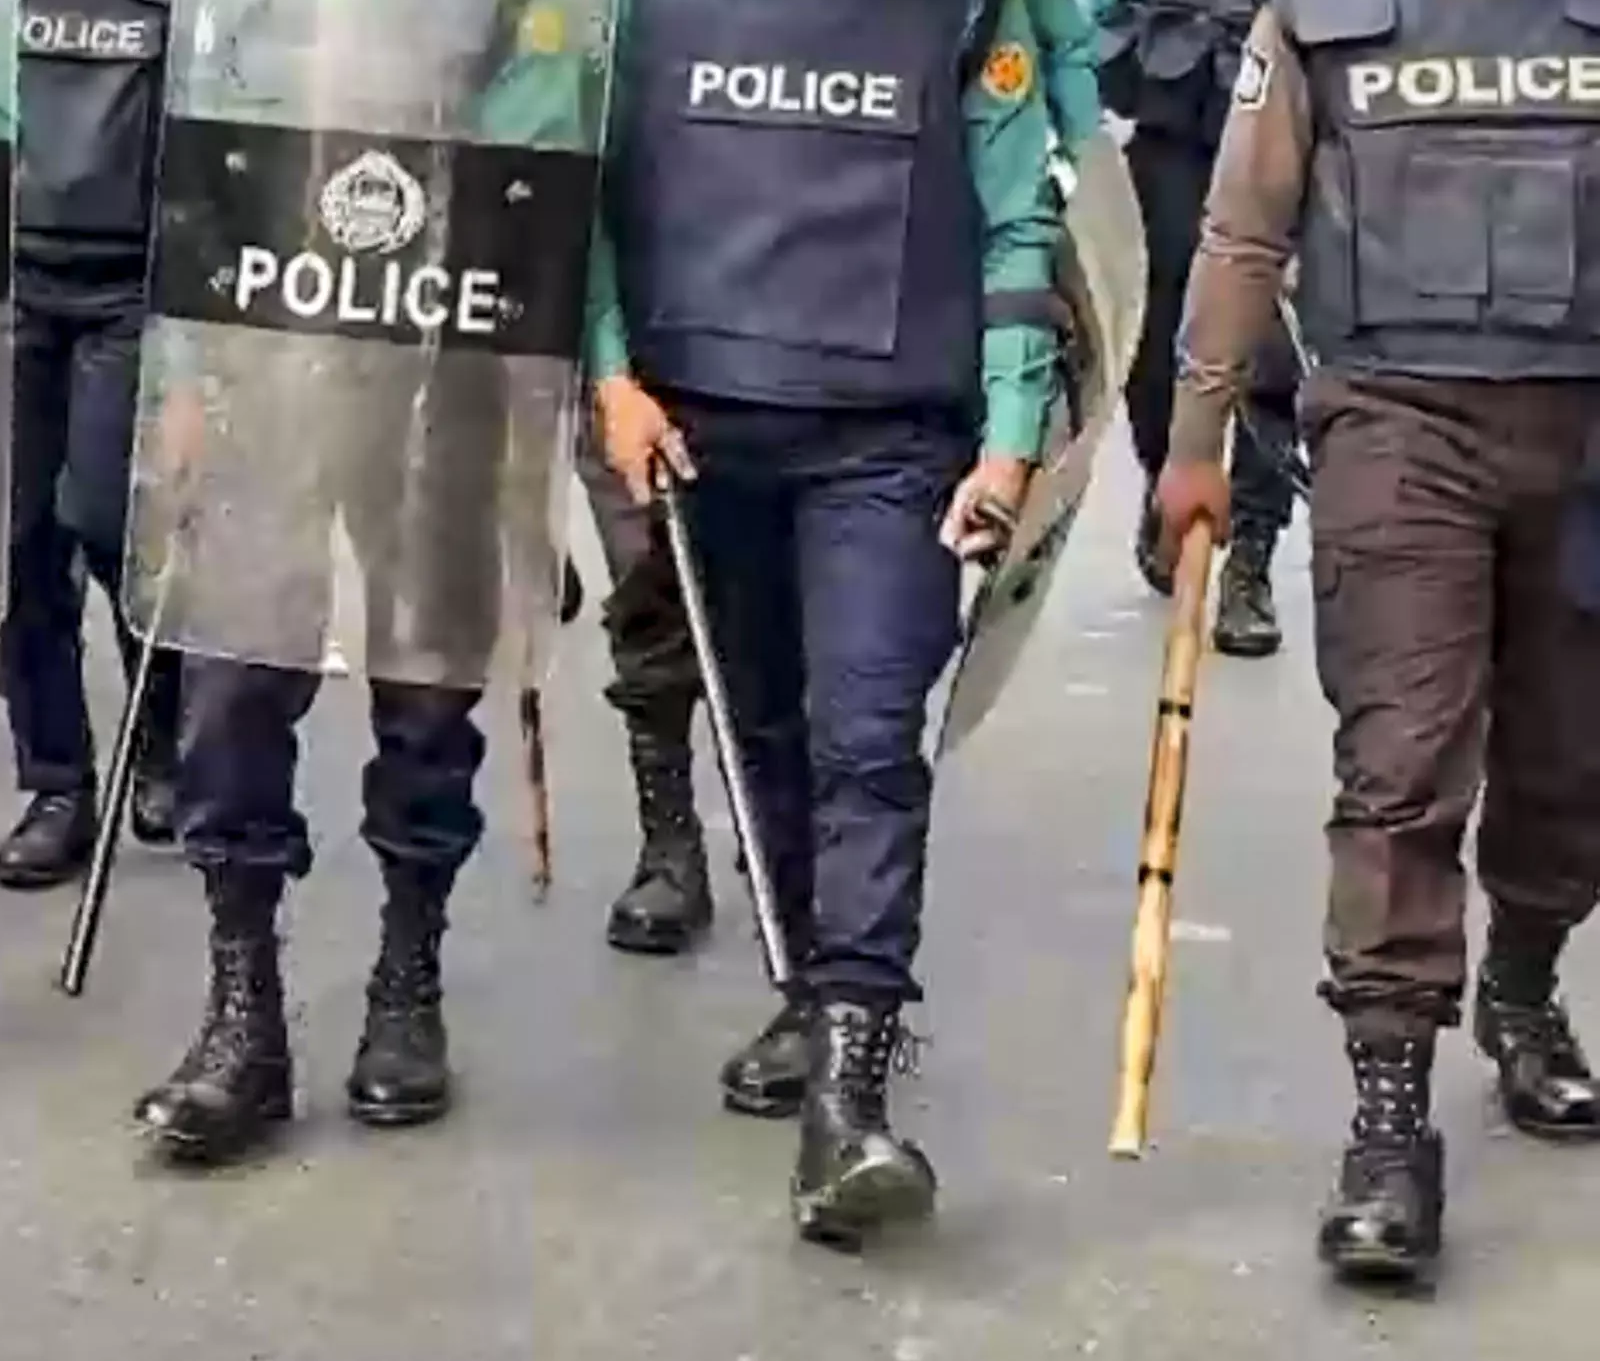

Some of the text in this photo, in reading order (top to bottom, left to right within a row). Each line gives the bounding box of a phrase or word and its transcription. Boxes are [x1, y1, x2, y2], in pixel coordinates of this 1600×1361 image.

[23, 14, 146, 56] OLICE
[690, 61, 901, 118] POLICE
[1347, 54, 1600, 112] POLICE
[238, 246, 499, 334] POLICE
